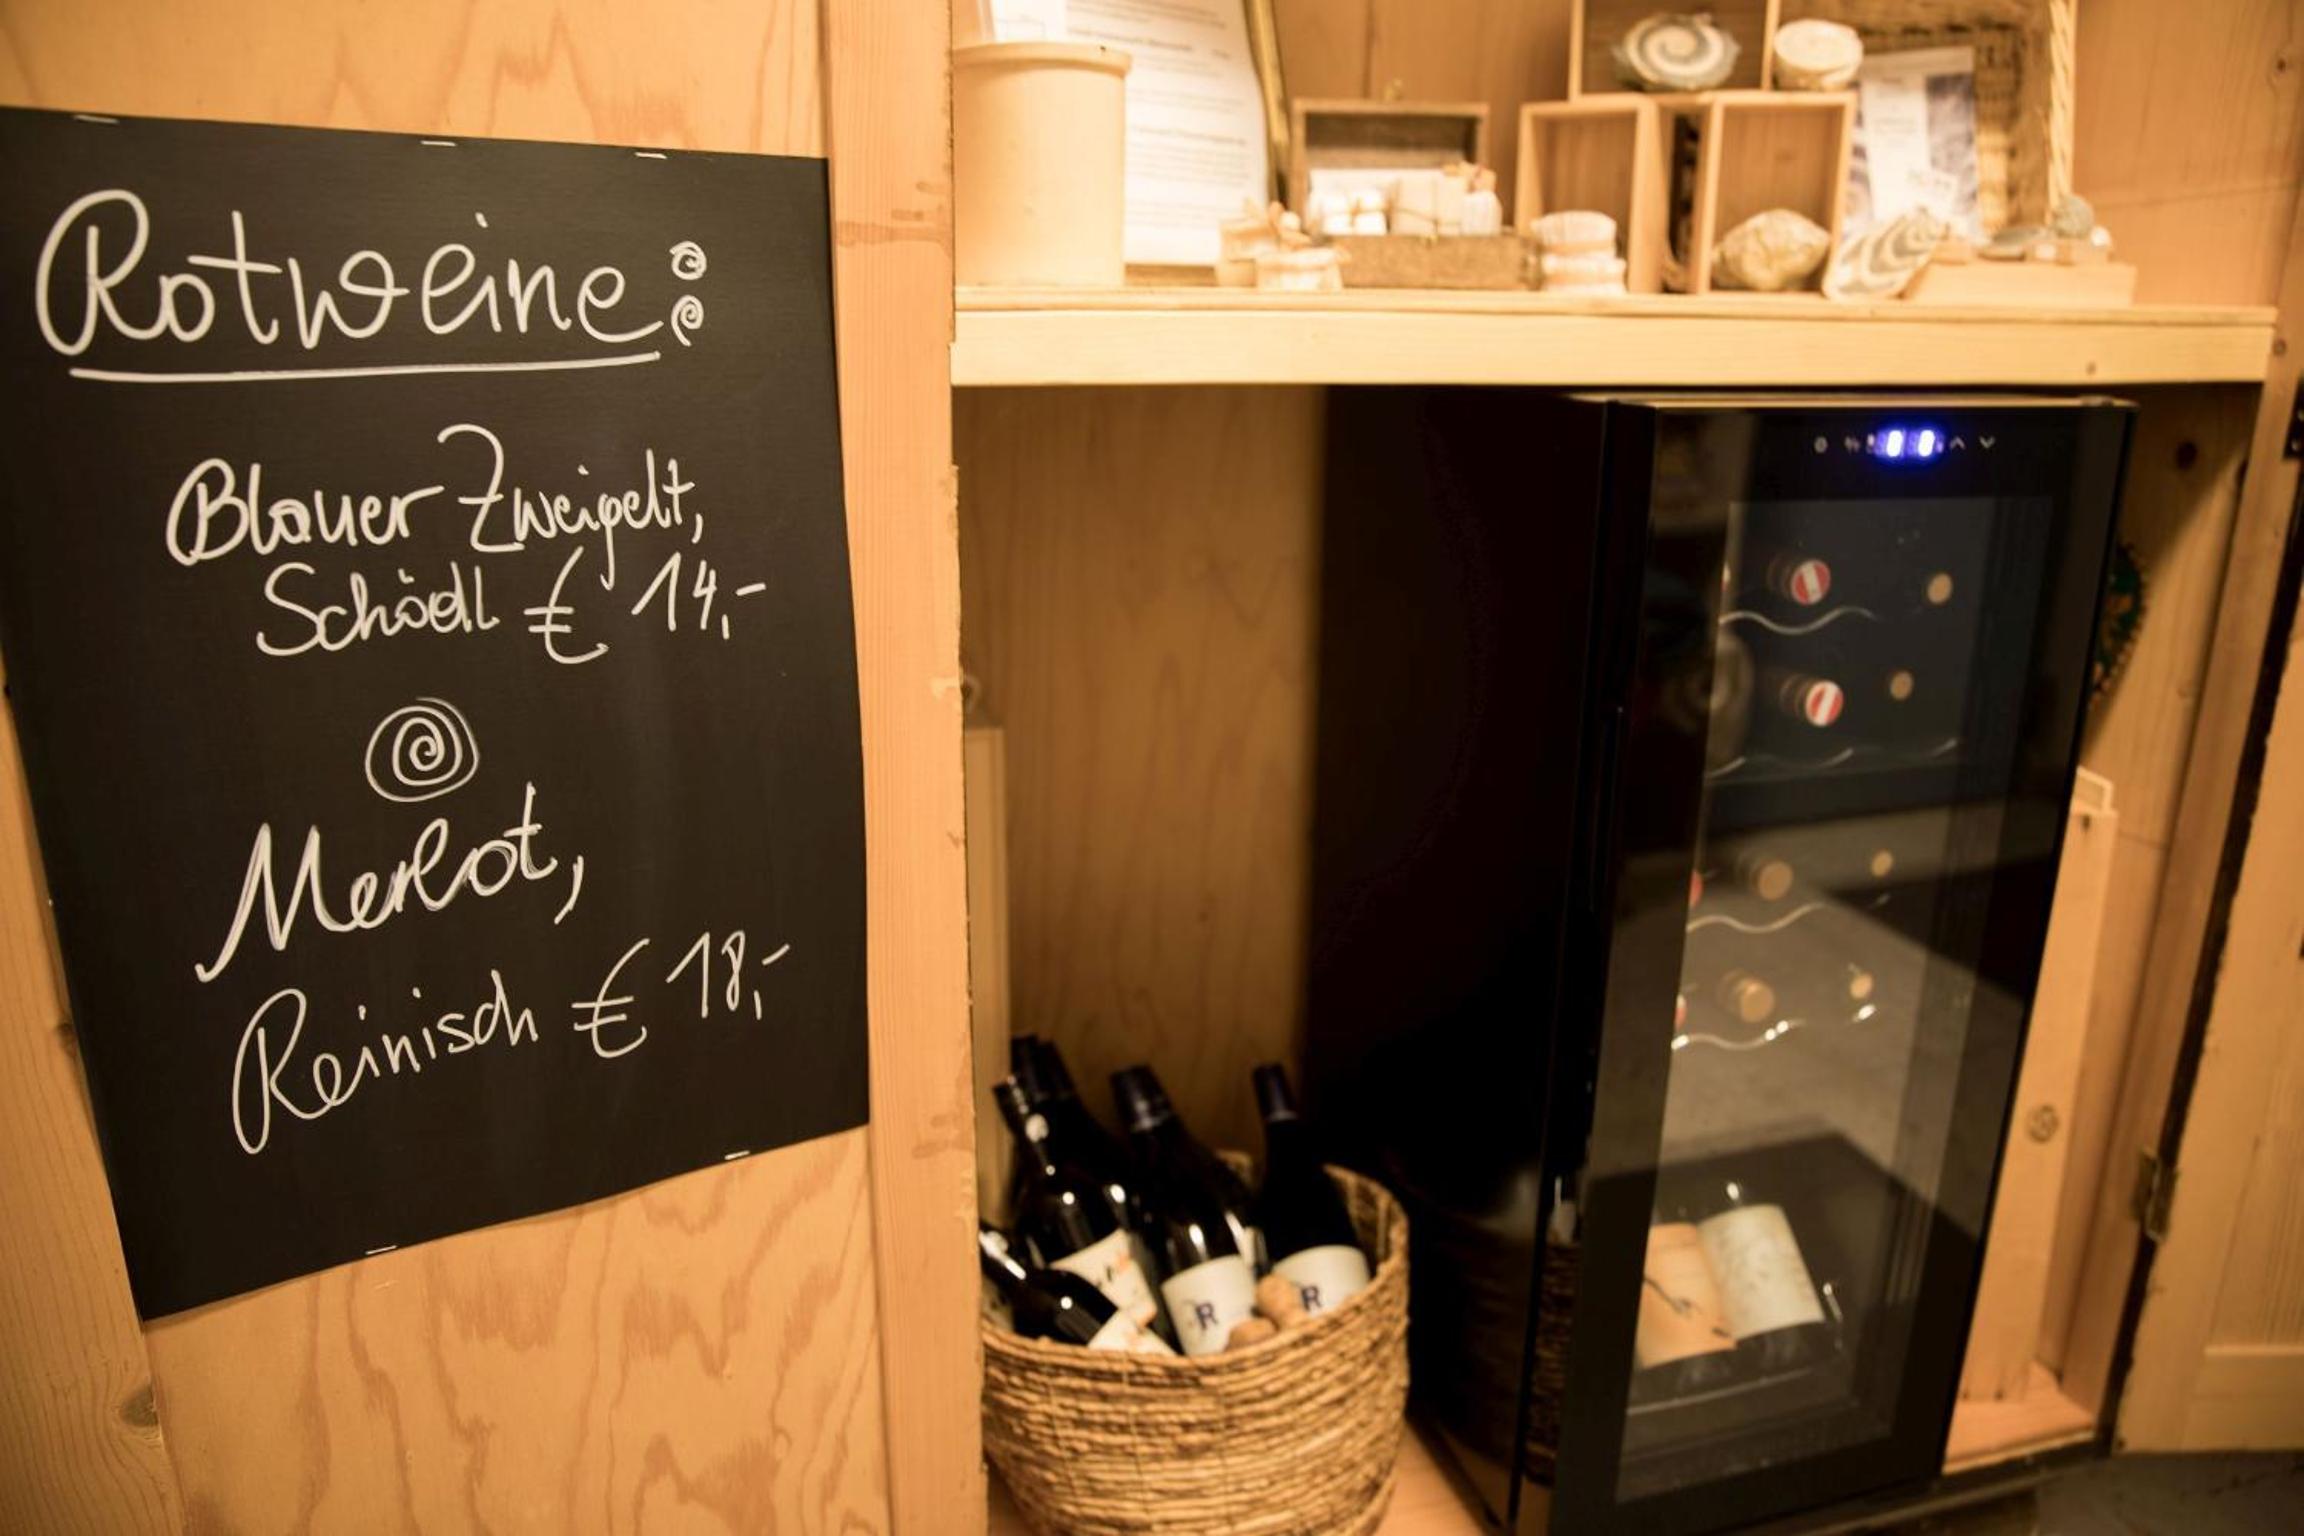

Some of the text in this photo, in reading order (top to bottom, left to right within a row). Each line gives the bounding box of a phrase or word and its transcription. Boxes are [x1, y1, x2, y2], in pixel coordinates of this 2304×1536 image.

[166, 424, 704, 591] Blauer Zweigelt,
[257, 546, 766, 664] Schödl € 14,-
[195, 781, 584, 982] Merlot,
[233, 931, 790, 1154] Reinisch € 18,-
